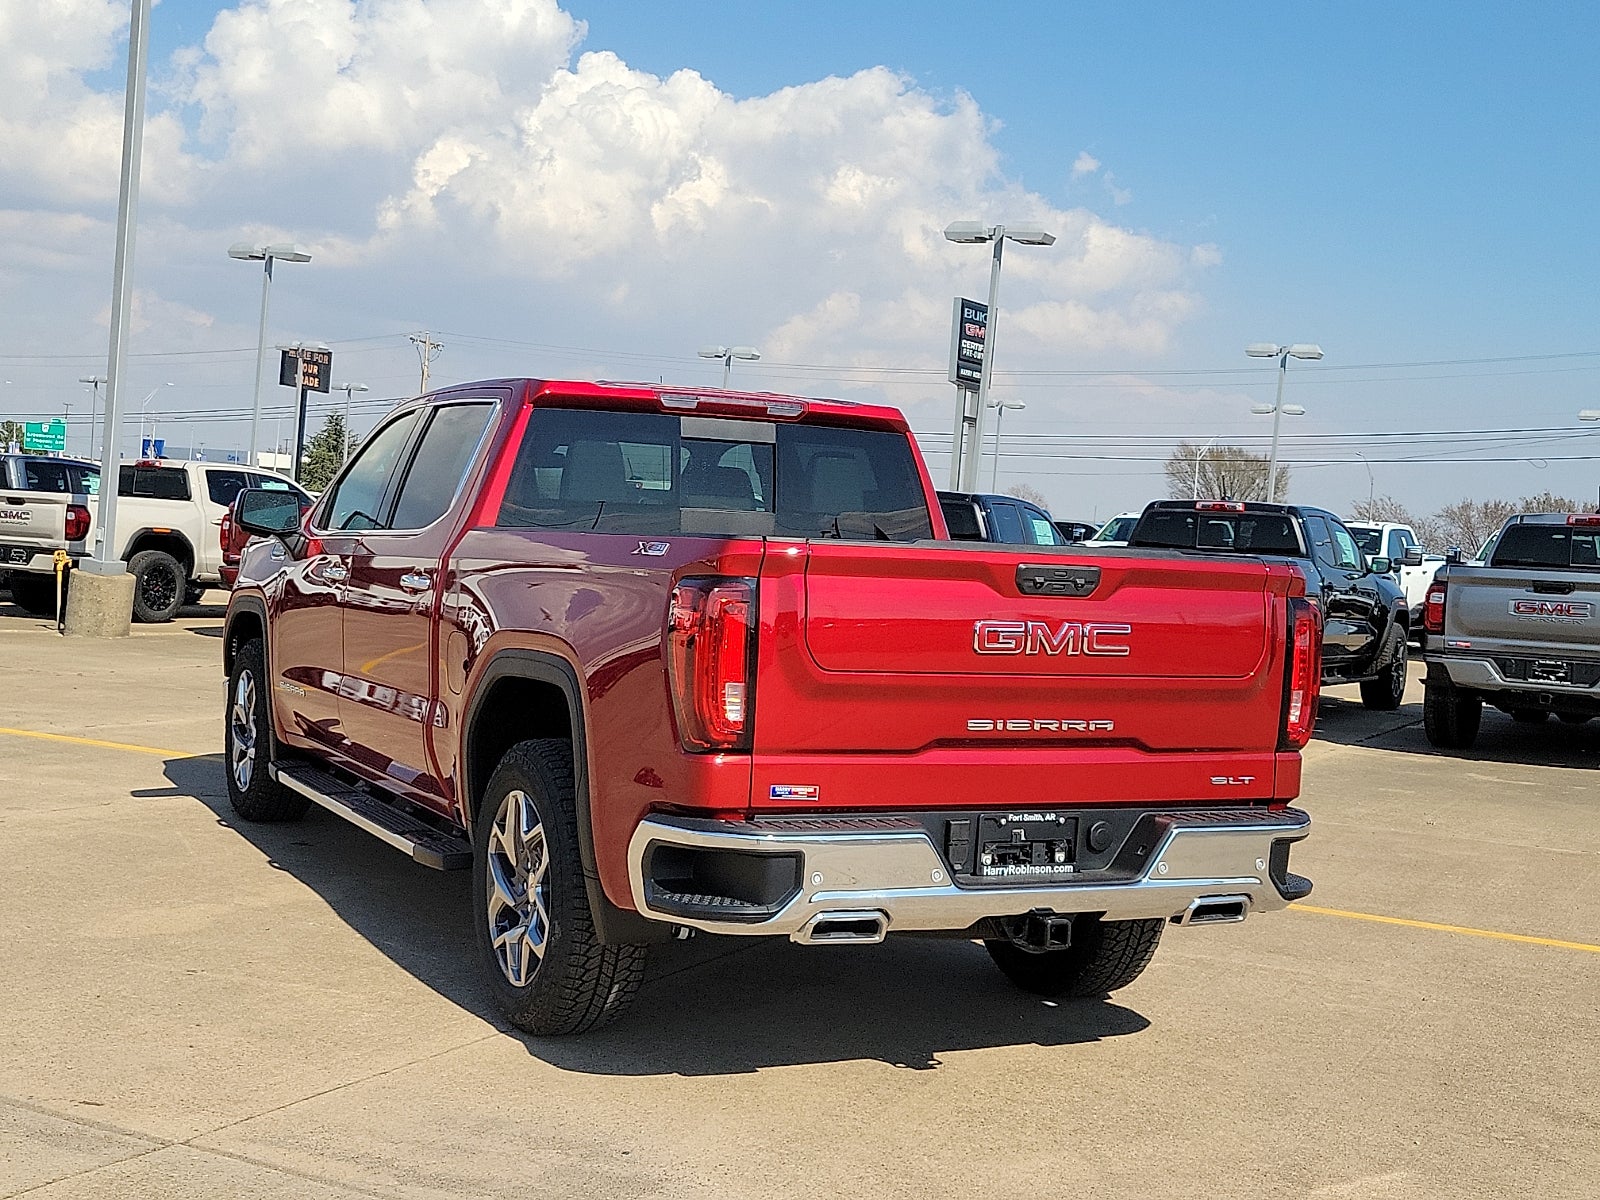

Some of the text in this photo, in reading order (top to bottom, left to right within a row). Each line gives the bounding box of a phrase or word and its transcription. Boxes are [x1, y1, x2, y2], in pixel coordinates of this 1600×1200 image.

[964, 307, 988, 324] BUIC
[965, 323, 986, 338] GM
[961, 340, 984, 352] CERTIF
[313, 352, 329, 365] FOR
[302, 362, 318, 375] OUR
[1515, 600, 1591, 618] GMC
[973, 620, 1132, 656] GMC
[966, 719, 1115, 732] SIERRA
[1210, 776, 1256, 785] SLT
[1008, 813, 1057, 822] Fort Smith, AR
[983, 865, 1074, 876] HarryRobinson.com
